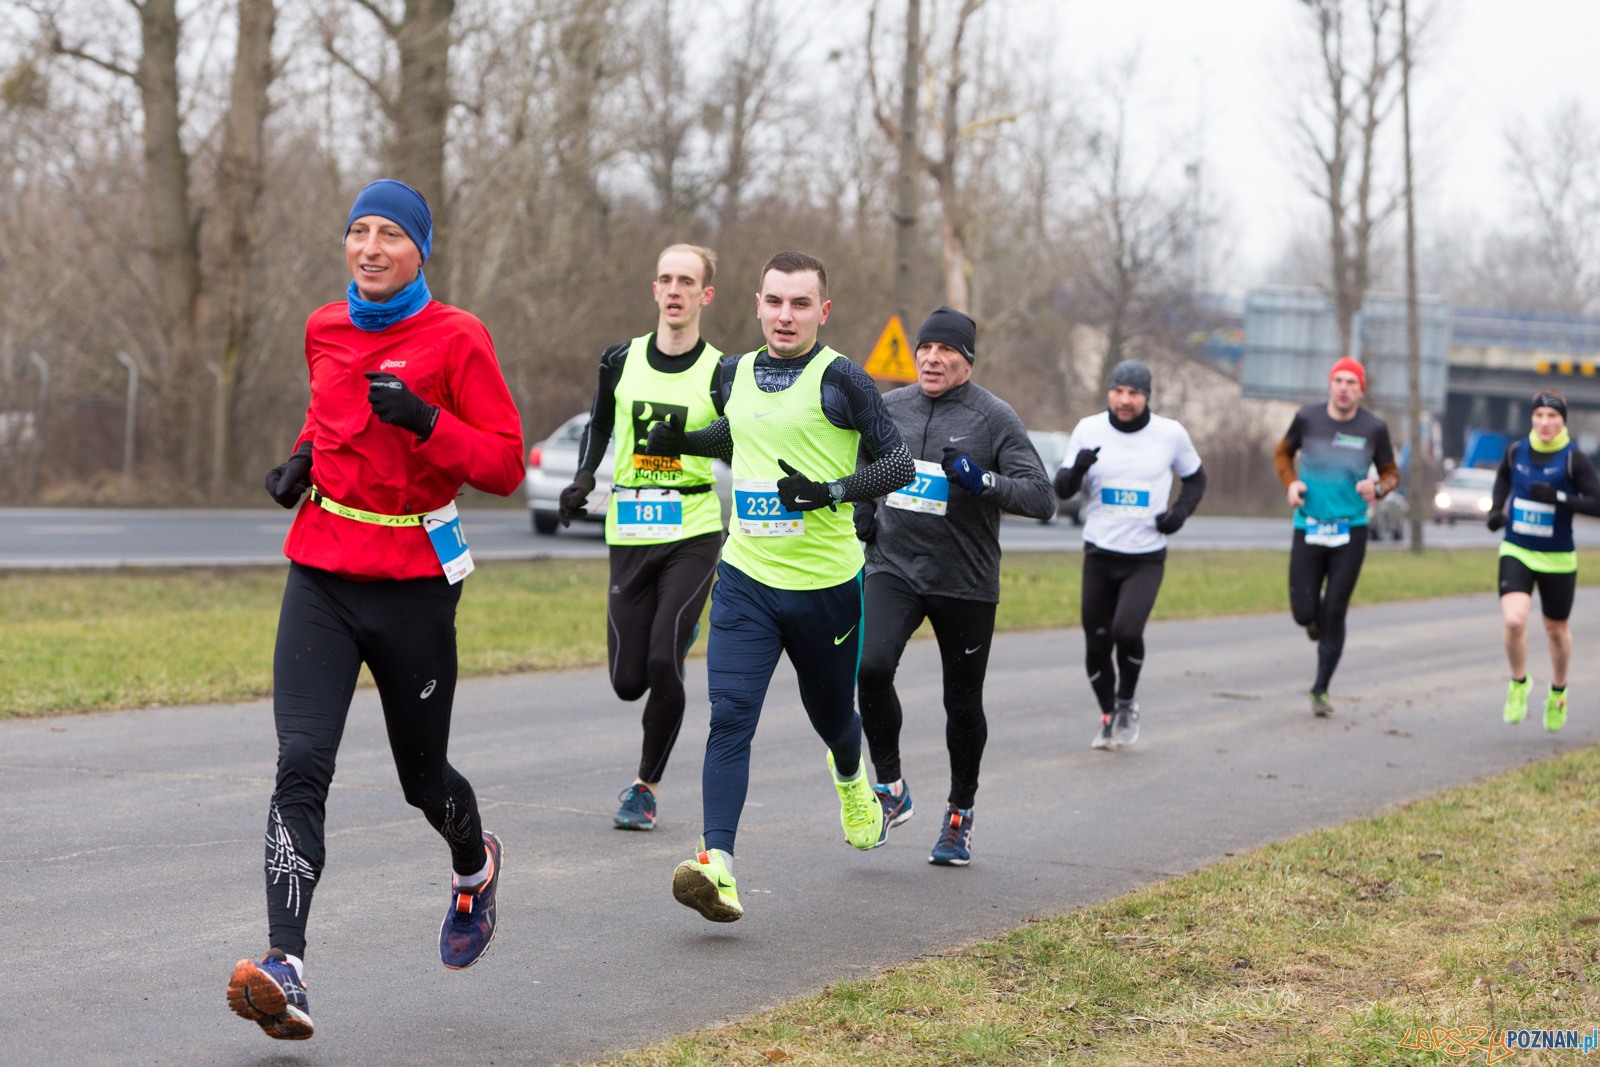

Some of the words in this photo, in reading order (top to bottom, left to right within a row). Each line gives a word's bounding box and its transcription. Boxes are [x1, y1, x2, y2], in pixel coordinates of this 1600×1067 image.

[641, 456, 674, 469] night
[903, 475, 932, 494] 27
[746, 496, 781, 516] 232
[1114, 490, 1138, 505] 120
[635, 504, 662, 521] 181
